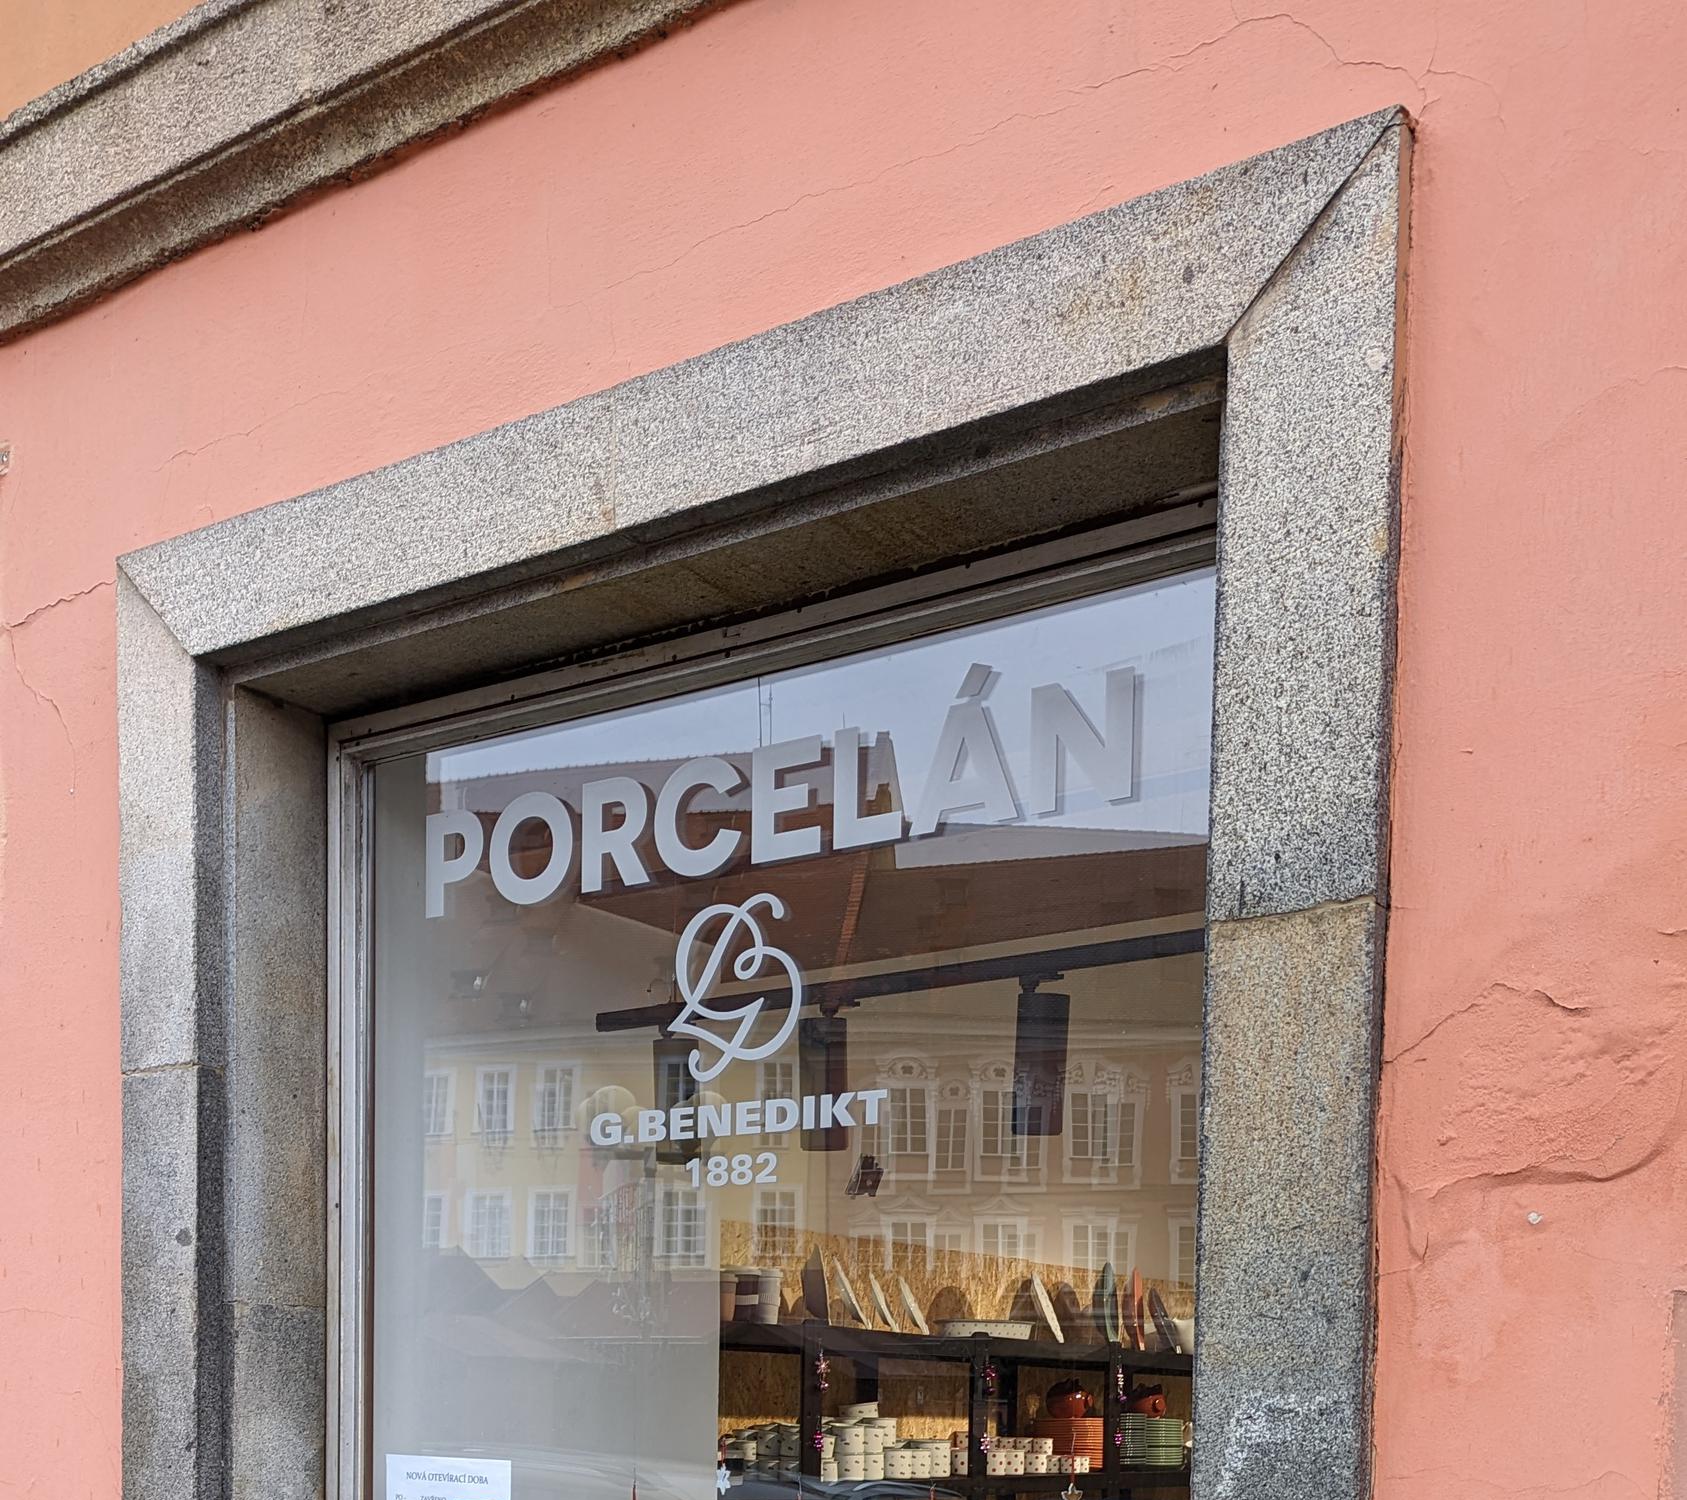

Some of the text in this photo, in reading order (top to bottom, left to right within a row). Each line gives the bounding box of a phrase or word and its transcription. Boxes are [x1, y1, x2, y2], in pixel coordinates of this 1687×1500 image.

[425, 661, 1136, 918] PORCELÁN
[590, 1088, 889, 1146] G.BENEDIKT
[685, 1152, 777, 1188] 1882
[406, 1471, 489, 1484] NOVÁ OTEVÍRACÍ DOBA
